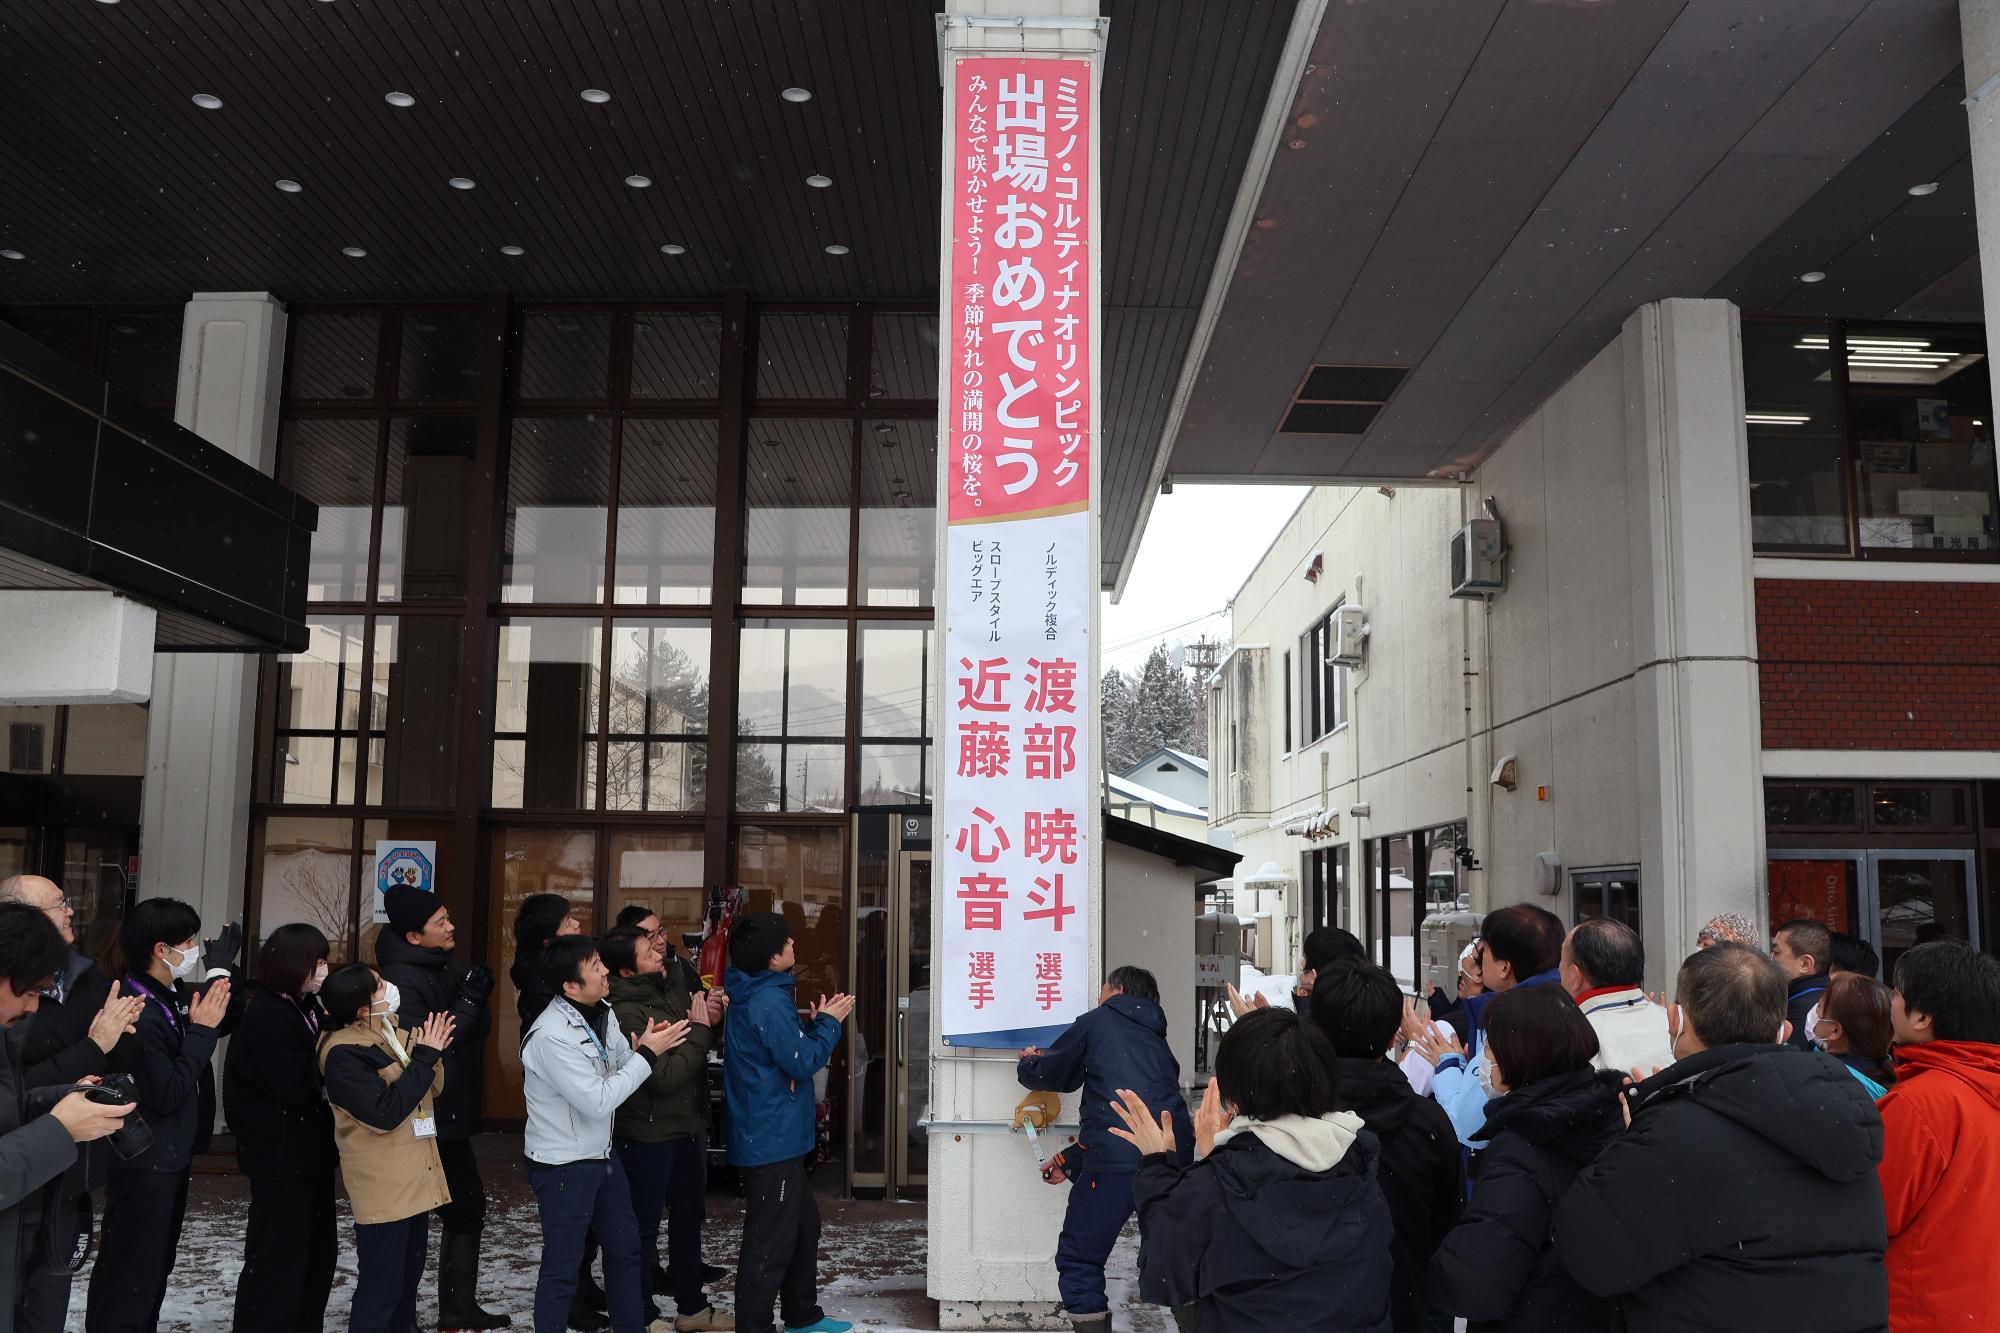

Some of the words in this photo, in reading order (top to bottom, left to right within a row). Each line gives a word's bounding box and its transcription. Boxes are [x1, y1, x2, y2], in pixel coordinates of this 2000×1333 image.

[991, 73, 1049, 496] 出場おめでとう
[1053, 77, 1082, 487] ミラノ・コルティナオリンピック
[971, 540, 984, 603] ビッグエア
[988, 541, 1002, 642] スロープスタイル
[1044, 542, 1058, 641] ノルディック複合
[957, 656, 1011, 778] 近藤
[1023, 657, 1077, 779] 渡部
[955, 806, 1011, 931] 心音
[1023, 807, 1078, 932] 暁斗
[968, 951, 995, 1010] 選手
[1035, 952, 1062, 1011] 選手
[73, 1233, 89, 1259] NPS
